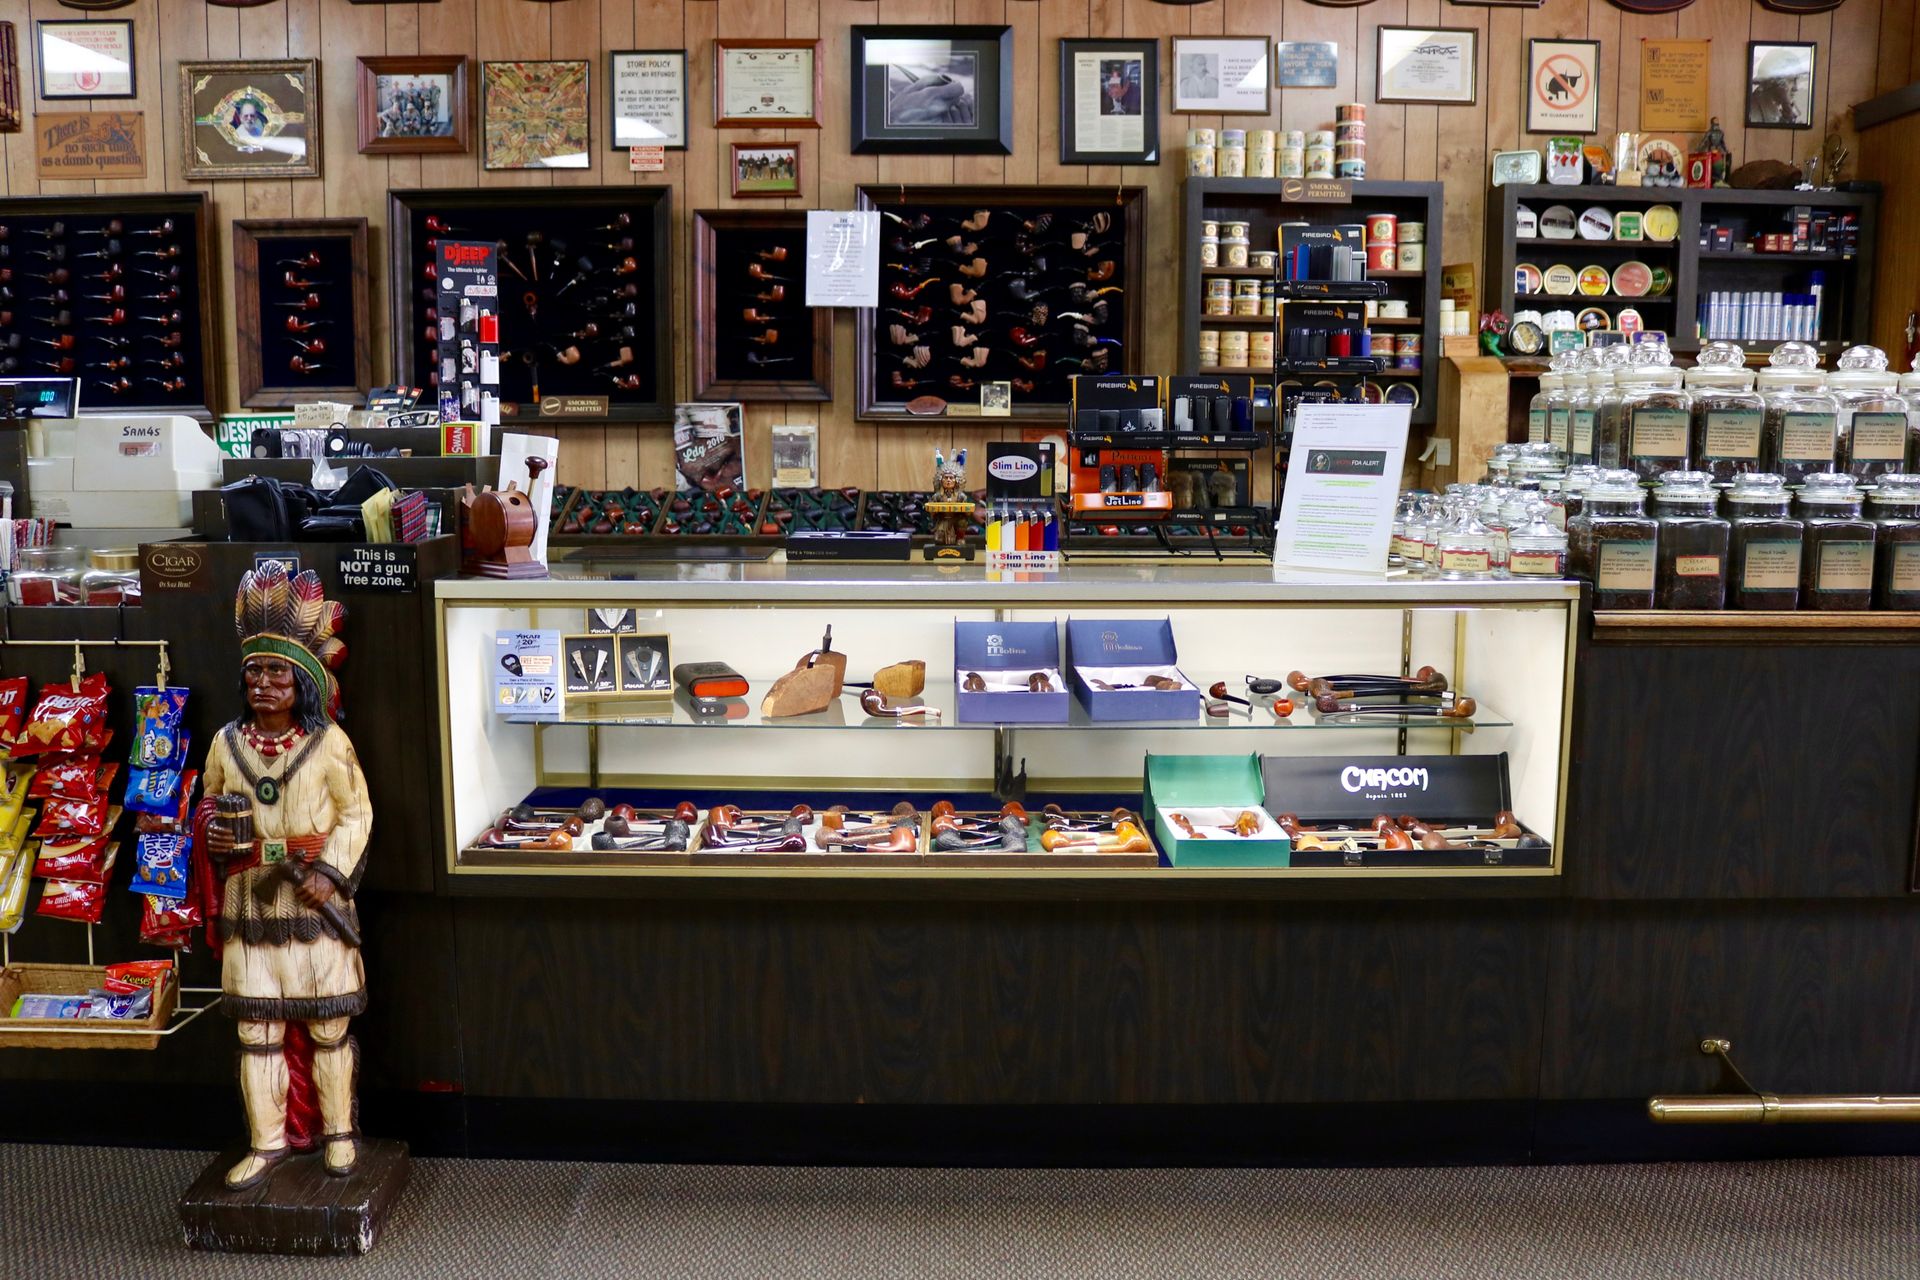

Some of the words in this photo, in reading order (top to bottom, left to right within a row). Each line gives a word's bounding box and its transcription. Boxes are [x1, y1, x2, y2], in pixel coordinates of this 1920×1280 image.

[80, 115, 91, 131] is
[43, 119, 78, 150] There
[64, 144, 79, 153] no
[81, 141, 106, 153] such
[42, 156, 53, 167] as
[55, 157, 62, 167] a
[63, 153, 93, 166] dumb
[95, 155, 142, 171] question
[1309, 183, 1342, 191] SMOKING
[1307, 190, 1346, 198] PERMITTED
[564, 405, 602, 413] PERMITTED
[451, 427, 464, 454] SWAN
[992, 461, 1012, 470] Slim
[1015, 461, 1035, 471] Line
[152, 553, 195, 567] CIGAR
[354, 549, 380, 561] This
[384, 549, 396, 561] is
[1000, 553, 1022, 561] Slim
[1024, 553, 1046, 561] Line
[340, 561, 372, 573] NOT
[374, 563, 382, 573] a
[385, 563, 410, 577] gun
[344, 576, 369, 585] free
[371, 576, 406, 586] zone.
[142, 730, 157, 765] Teddy
[156, 768, 171, 799] REO
[1341, 766, 1429, 792] CHACOM
[1366, 792, 1388, 801] Depuis
